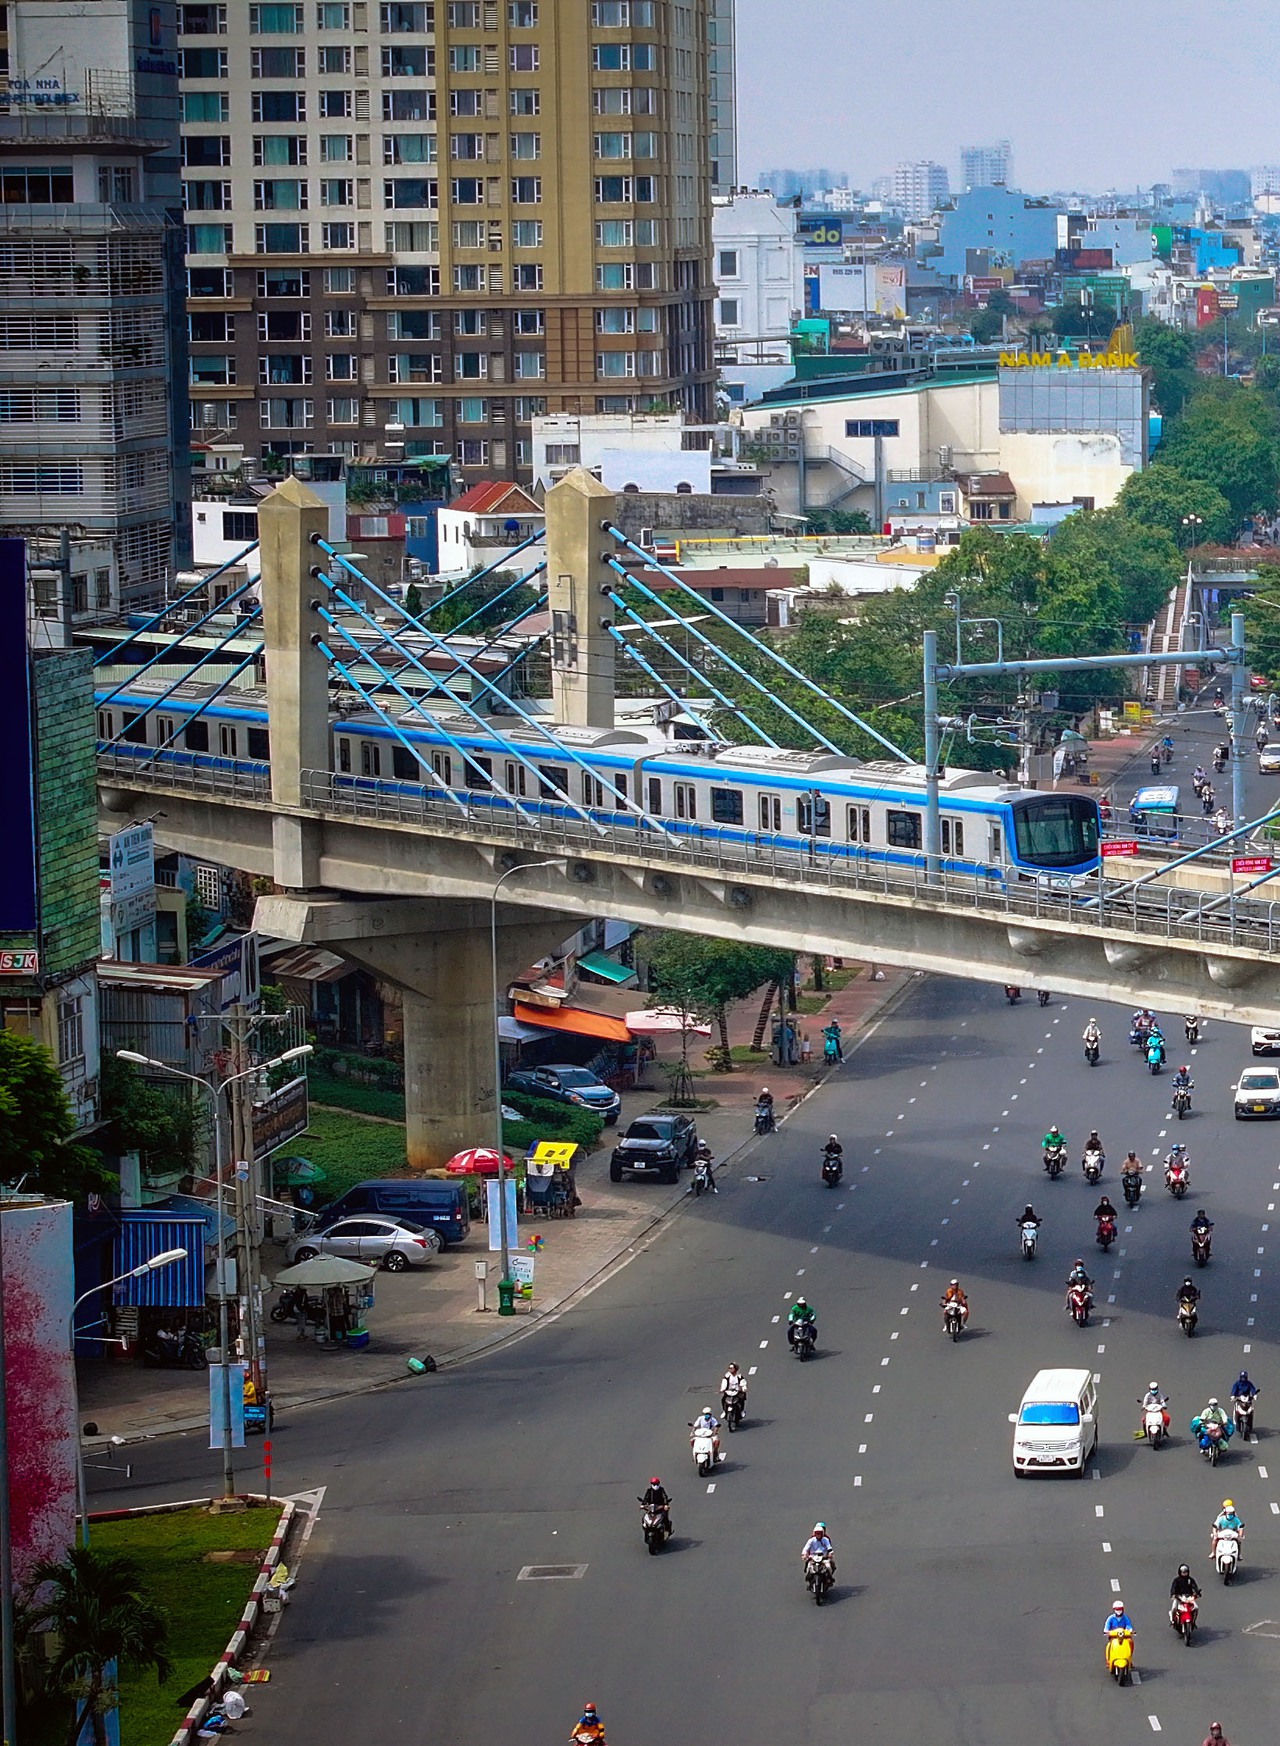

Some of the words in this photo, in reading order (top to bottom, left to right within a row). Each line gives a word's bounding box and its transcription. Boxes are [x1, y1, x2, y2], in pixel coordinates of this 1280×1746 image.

[999, 352, 1051, 367] NAM
[1078, 352, 1140, 368] BANK
[2, 954, 35, 969] SJK
